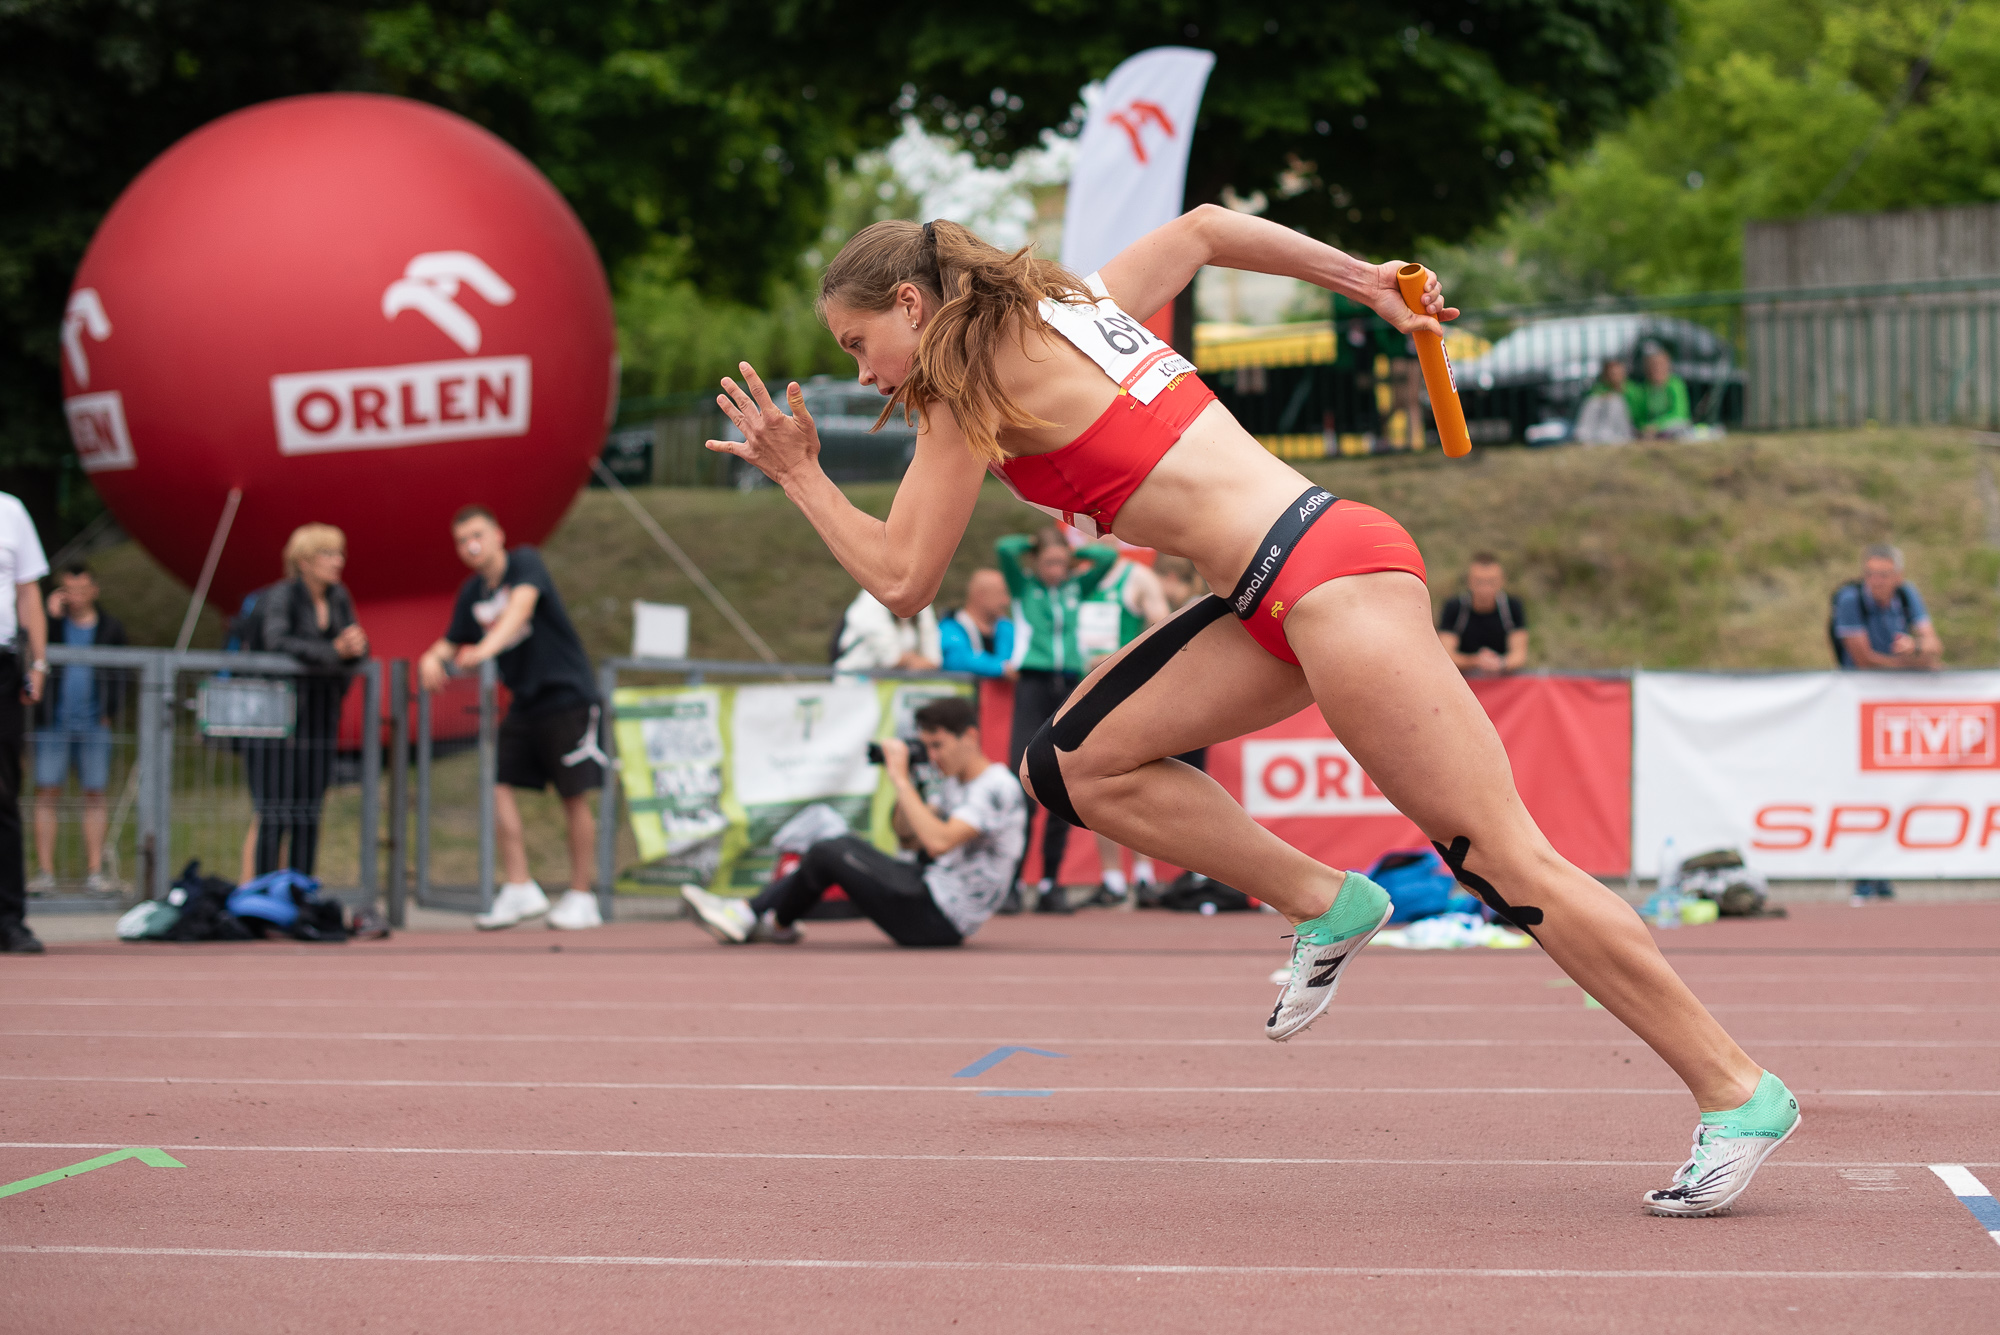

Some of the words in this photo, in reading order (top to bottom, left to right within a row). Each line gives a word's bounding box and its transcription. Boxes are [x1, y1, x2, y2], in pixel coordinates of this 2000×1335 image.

[296, 372, 512, 434] ORLEN
[1235, 544, 1282, 614] AdRunaLine
[1882, 714, 1987, 757] TVP
[1755, 1130, 1779, 1138] balance
